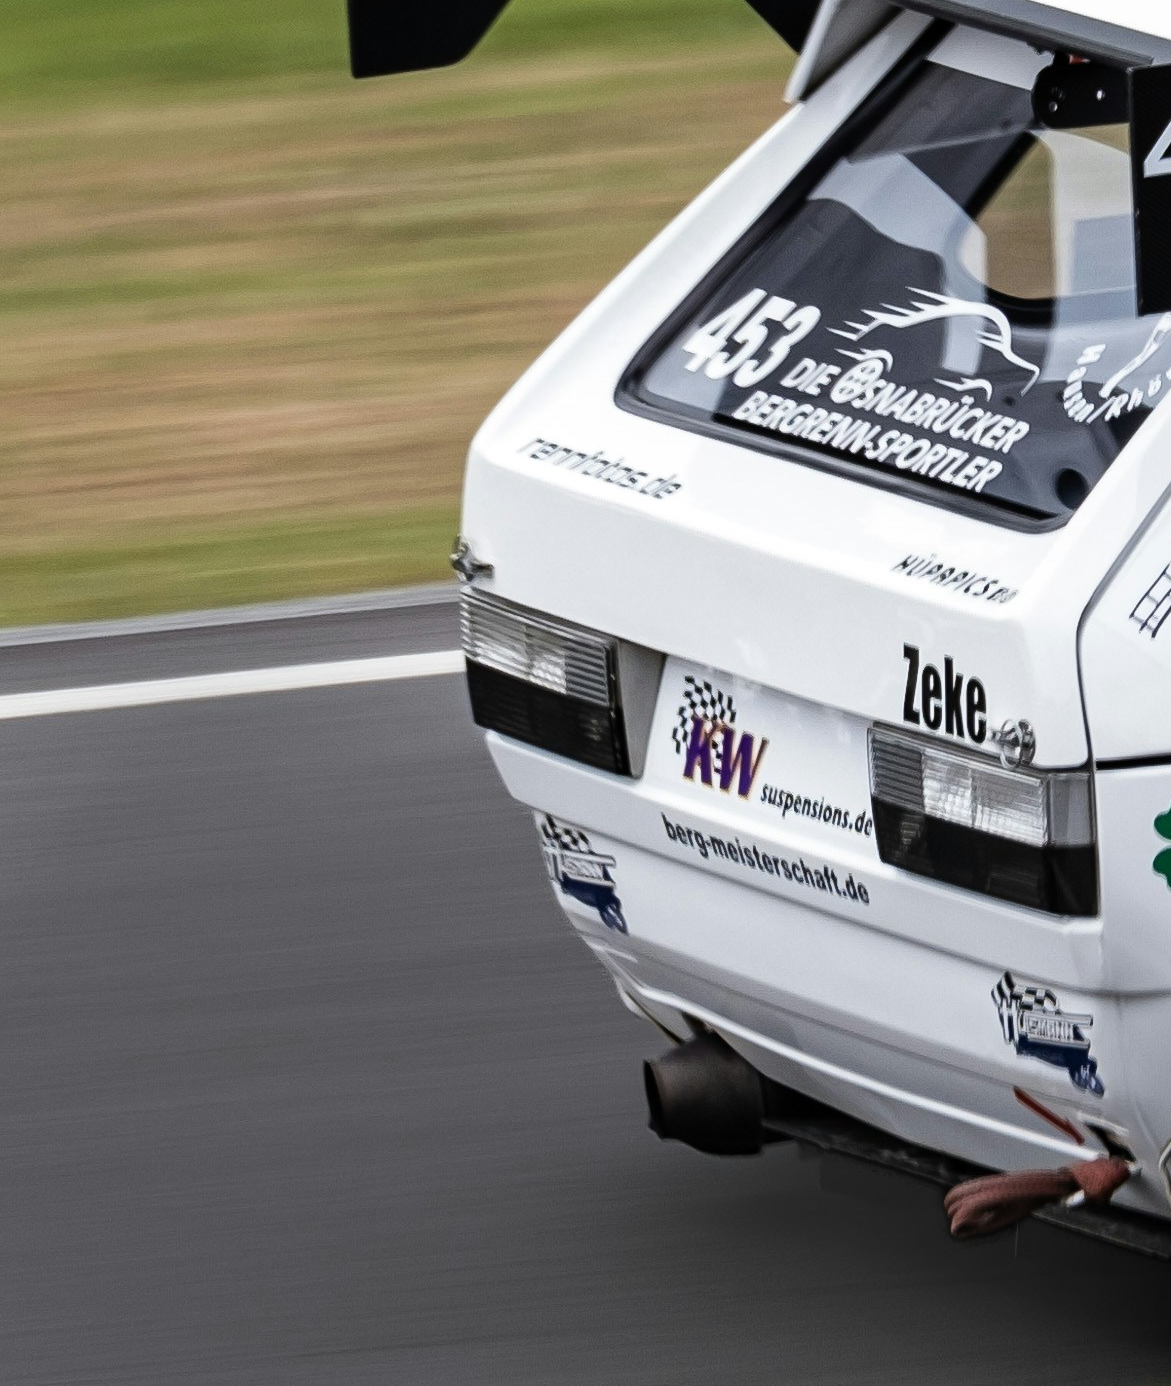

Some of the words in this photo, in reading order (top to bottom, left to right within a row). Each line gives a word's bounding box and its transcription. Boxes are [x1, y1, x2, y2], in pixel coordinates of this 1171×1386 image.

[682, 287, 821, 388] 453
[731, 390, 1004, 493] BERGRENN-SPORTLER
[780, 358, 841, 396] DIE
[830, 357, 1030, 454] OSNABRÜCKER
[902, 642, 987, 744] Zeke
[682, 712, 770, 801] KW
[760, 782, 874, 838] suspensions.de
[660, 812, 870, 906] berg-meisterschaft.de
